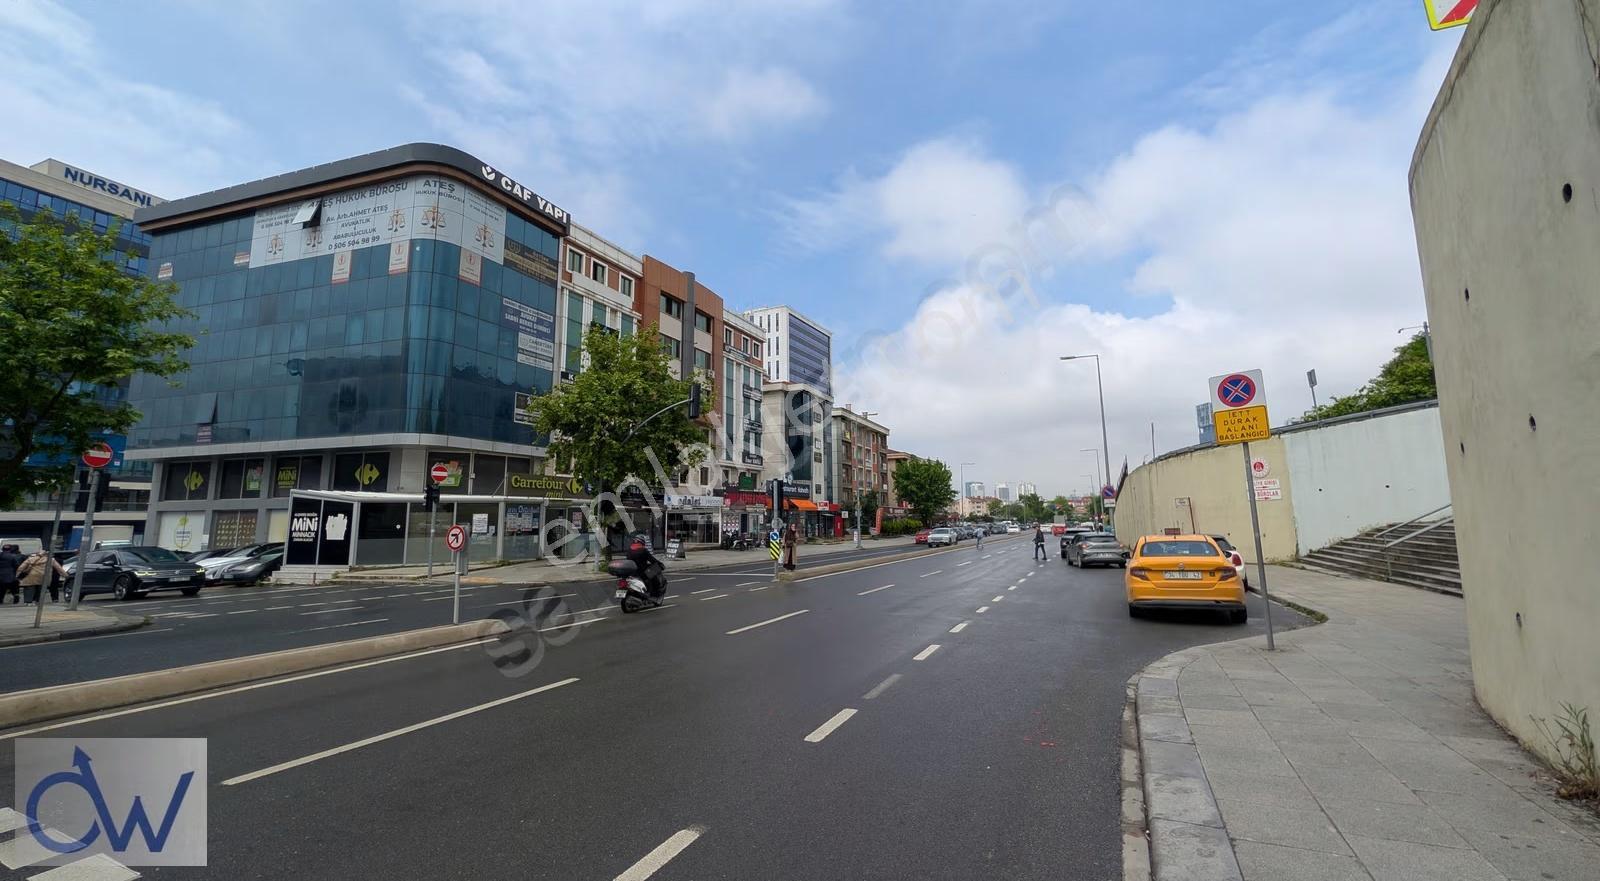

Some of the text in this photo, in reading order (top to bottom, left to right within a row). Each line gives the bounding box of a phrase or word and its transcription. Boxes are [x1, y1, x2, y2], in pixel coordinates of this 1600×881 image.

[423, 180, 456, 193] ATEŞ
[335, 190, 367, 205] HUKUK
[369, 181, 408, 198] BÜROSU
[501, 176, 532, 201] CAF
[536, 195, 567, 223] YAPI
[372, 204, 389, 213] ATEŞ
[1223, 417, 1258, 426] DURAK
[1226, 424, 1258, 433] ALANI
[511, 475, 564, 490] Carrefour
[545, 490, 563, 498] mini
